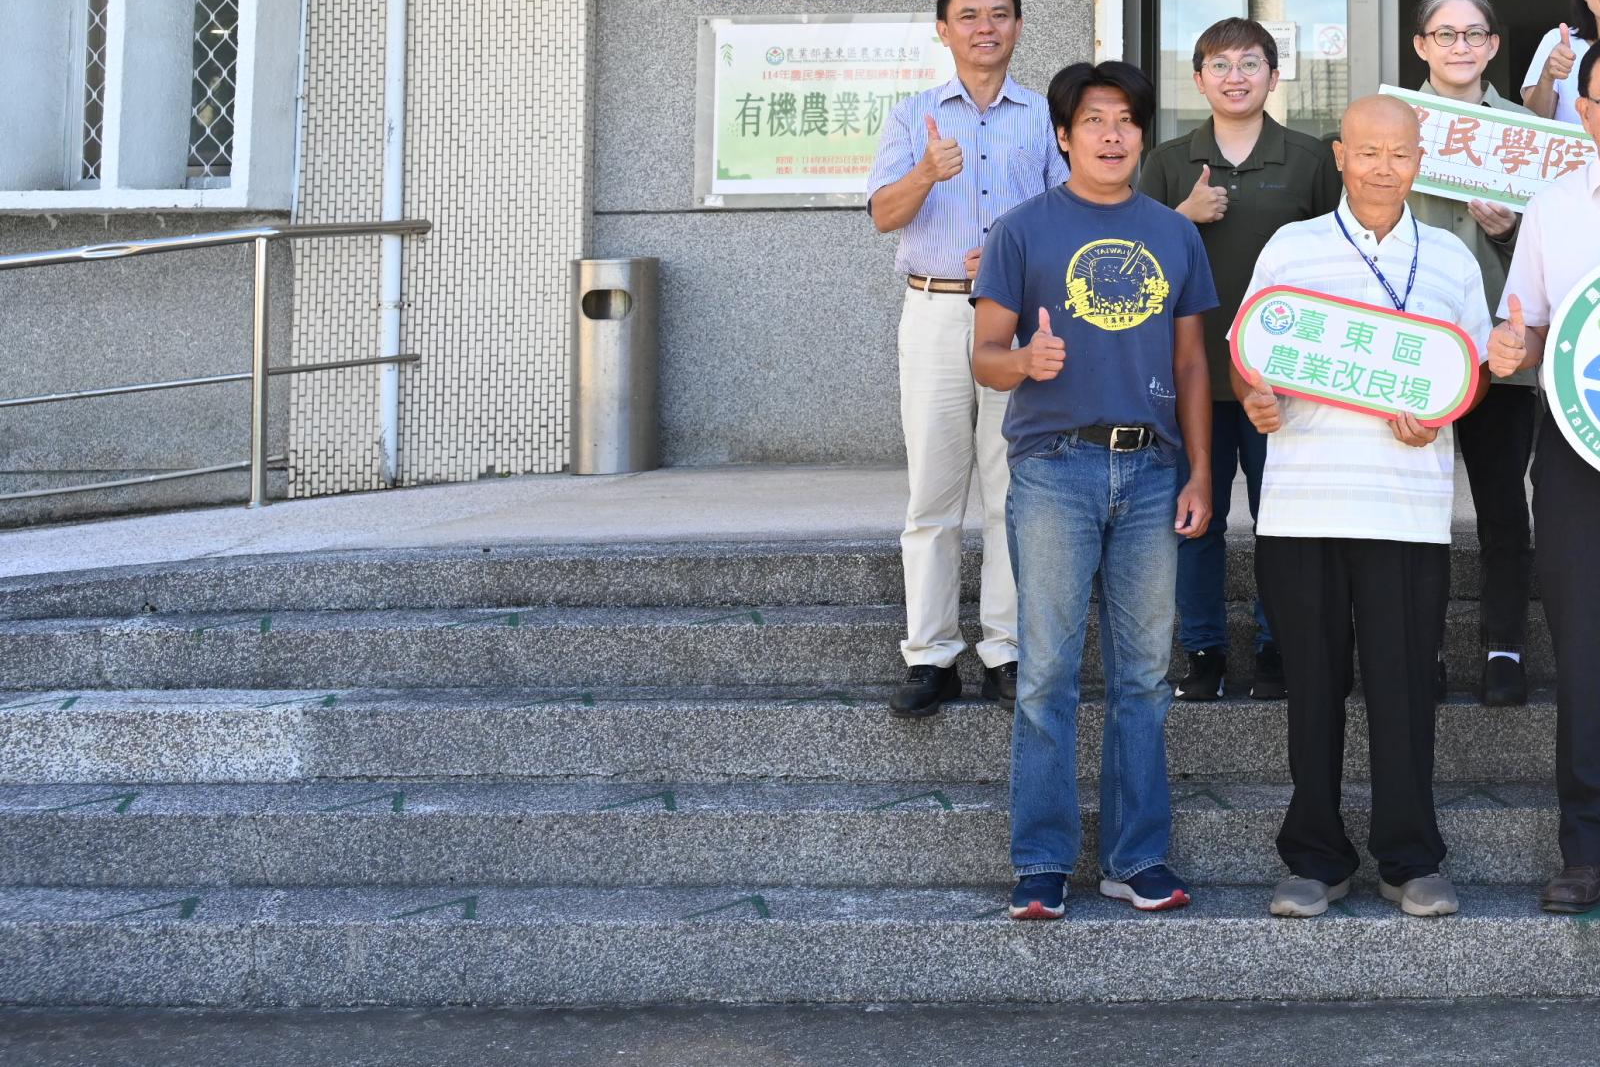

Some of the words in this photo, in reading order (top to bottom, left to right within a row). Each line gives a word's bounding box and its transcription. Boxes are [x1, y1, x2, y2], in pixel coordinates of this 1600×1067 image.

[734, 91, 920, 137] 有機農業初
[1292, 308, 1427, 366] 臺東區
[1263, 344, 1432, 410] 農業改良場
